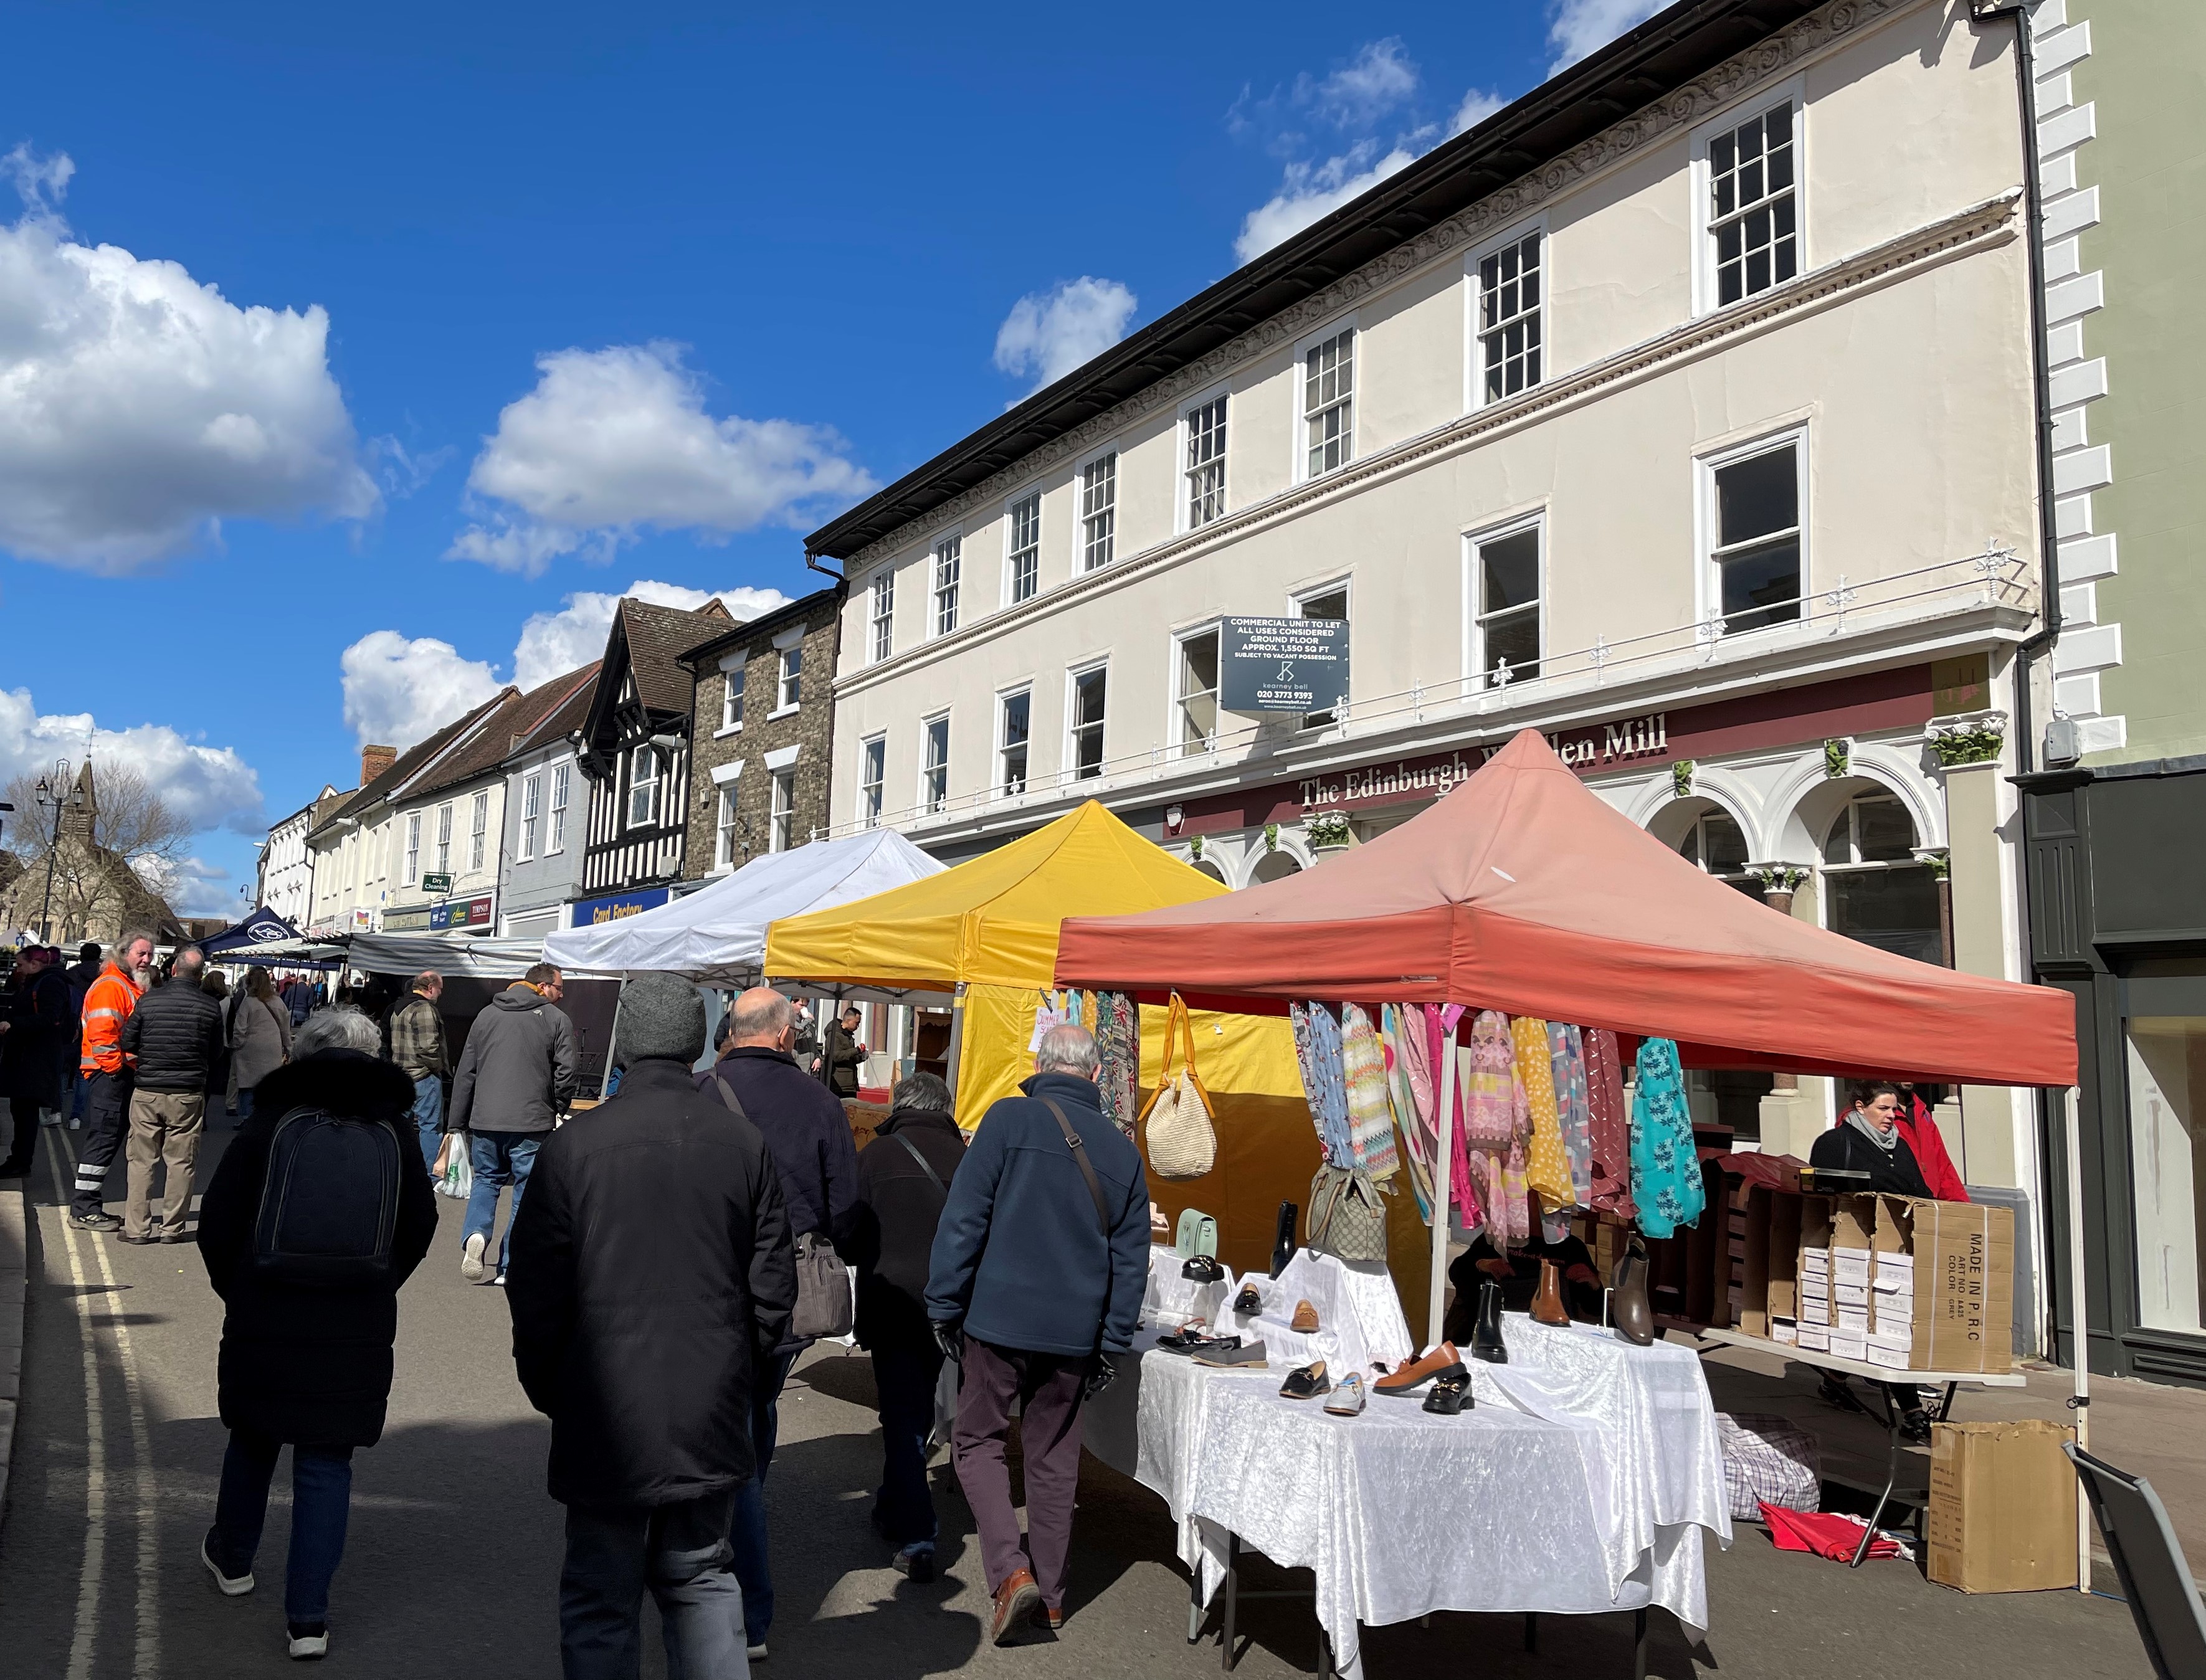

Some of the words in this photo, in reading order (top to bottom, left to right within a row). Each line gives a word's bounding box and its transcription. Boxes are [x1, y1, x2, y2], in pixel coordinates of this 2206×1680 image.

[1230, 619, 1287, 627] COMMERCIAL
[1279, 629, 1334, 637] CONSIDERED
[1242, 643, 1279, 652] APPROX.
[1294, 691, 1313, 700] 9393
[1299, 777, 1339, 807] The
[1344, 751, 1468, 801] Edinburgh
[1603, 713, 1668, 758] Mill
[593, 904, 611, 924] Card
[613, 902, 642, 920] Factory
[1969, 1233, 1982, 1274] MADE
[1969, 1281, 1980, 1296] IN
